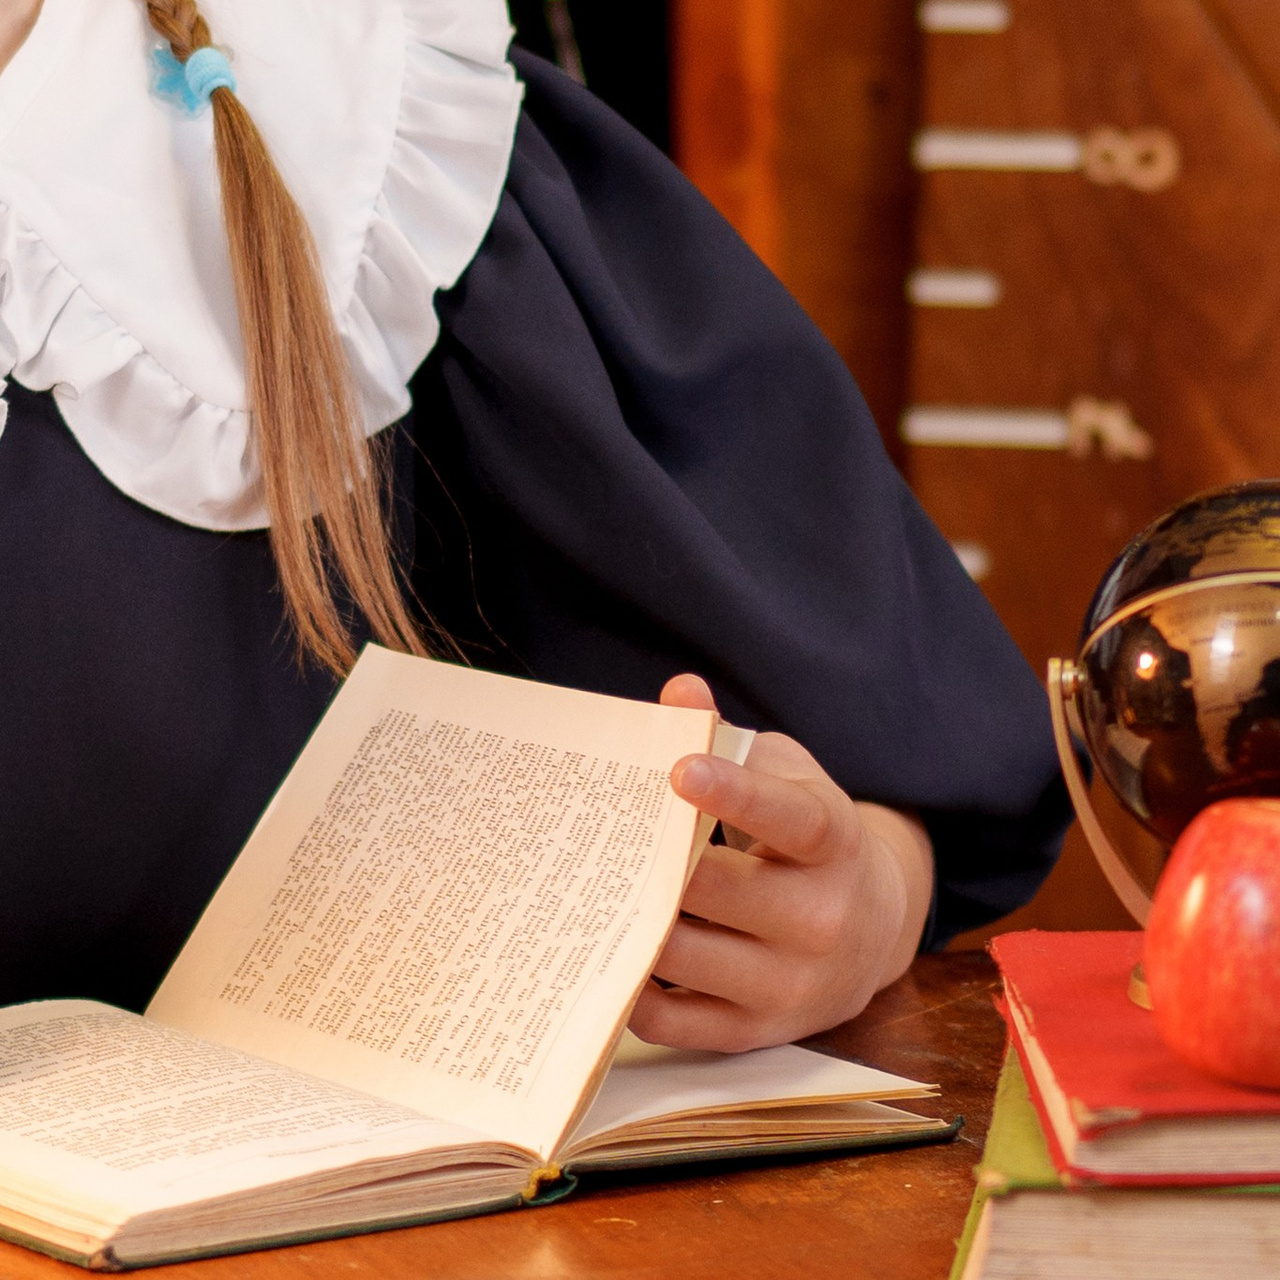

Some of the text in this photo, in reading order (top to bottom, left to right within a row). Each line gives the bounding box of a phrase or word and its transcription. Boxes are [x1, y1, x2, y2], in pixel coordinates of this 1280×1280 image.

[1083, 126, 1180, 193] 8
[383, 711, 410, 749] raining
[390, 727, 421, 766] Getting
[416, 719, 440, 751] empty
[346, 755, 375, 797] stranger
[401, 753, 420, 779] glass
[500, 742, 528, 784] Waking
[361, 786, 383, 813] reply
[518, 795, 541, 831] passed
[576, 811, 609, 869] diphtheria
[303, 851, 324, 880] again
[548, 851, 574, 887] Things
[274, 883, 304, 926] someone
[422, 877, 451, 918] realised
[467, 864, 503, 914] agonising
[315, 889, 347, 928] holding
[540, 897, 564, 933] settled
[232, 937, 262, 978] moment
[264, 944, 284, 971] clock
[478, 920, 505, 959] noticed
[598, 923, 632, 976] CHEKHOV
[354, 969, 375, 998] again
[467, 978, 489, 1008] asked
[497, 976, 518, 1005] nasal
[329, 1001, 357, 1035] falling
[346, 1013, 368, 1042] block
[415, 1008, 453, 1063] diphtheria
